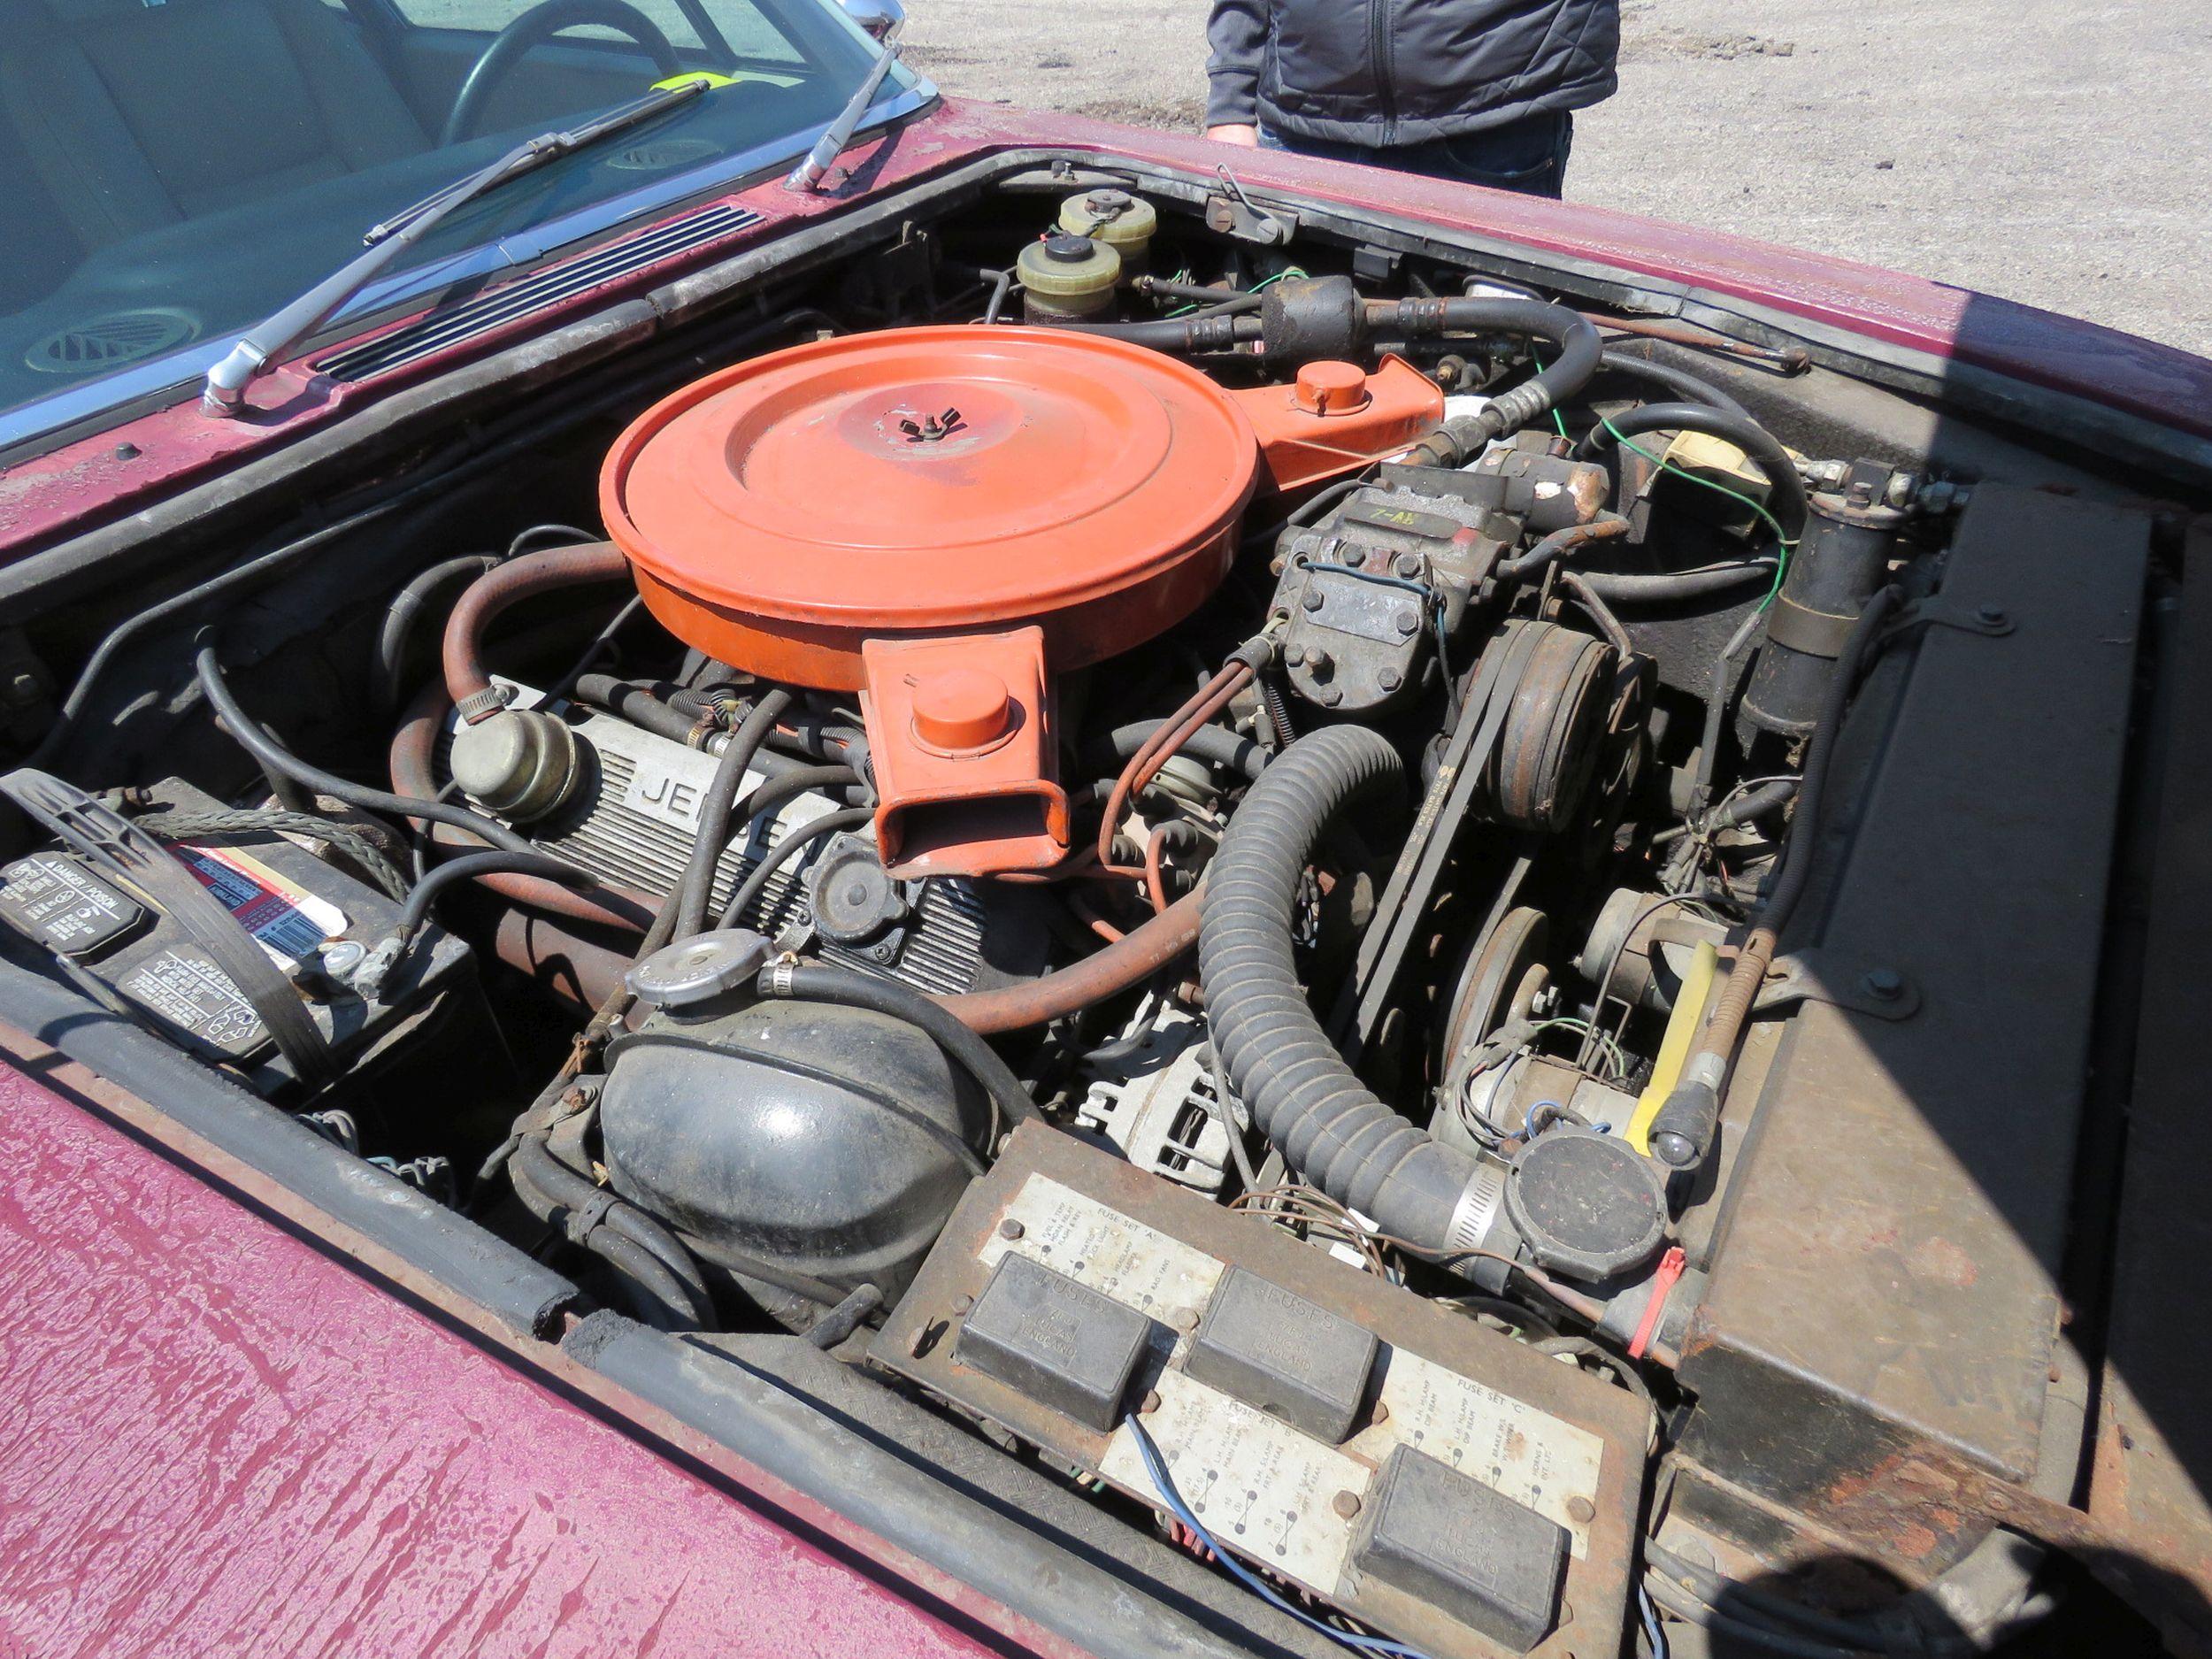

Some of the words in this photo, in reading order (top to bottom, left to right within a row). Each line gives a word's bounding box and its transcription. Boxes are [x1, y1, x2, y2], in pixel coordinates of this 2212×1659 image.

[1097, 1208, 1119, 1223] FUSE
[1124, 1220, 1139, 1232] SET
[1021, 1326, 1078, 1357] ENGLAND
[1256, 1339, 1313, 1371] ENGLAND
[1457, 1379, 1483, 1396] FUSE
[1487, 1392, 1505, 1406] SET
[1492, 1434, 1502, 1457] BRAKE
